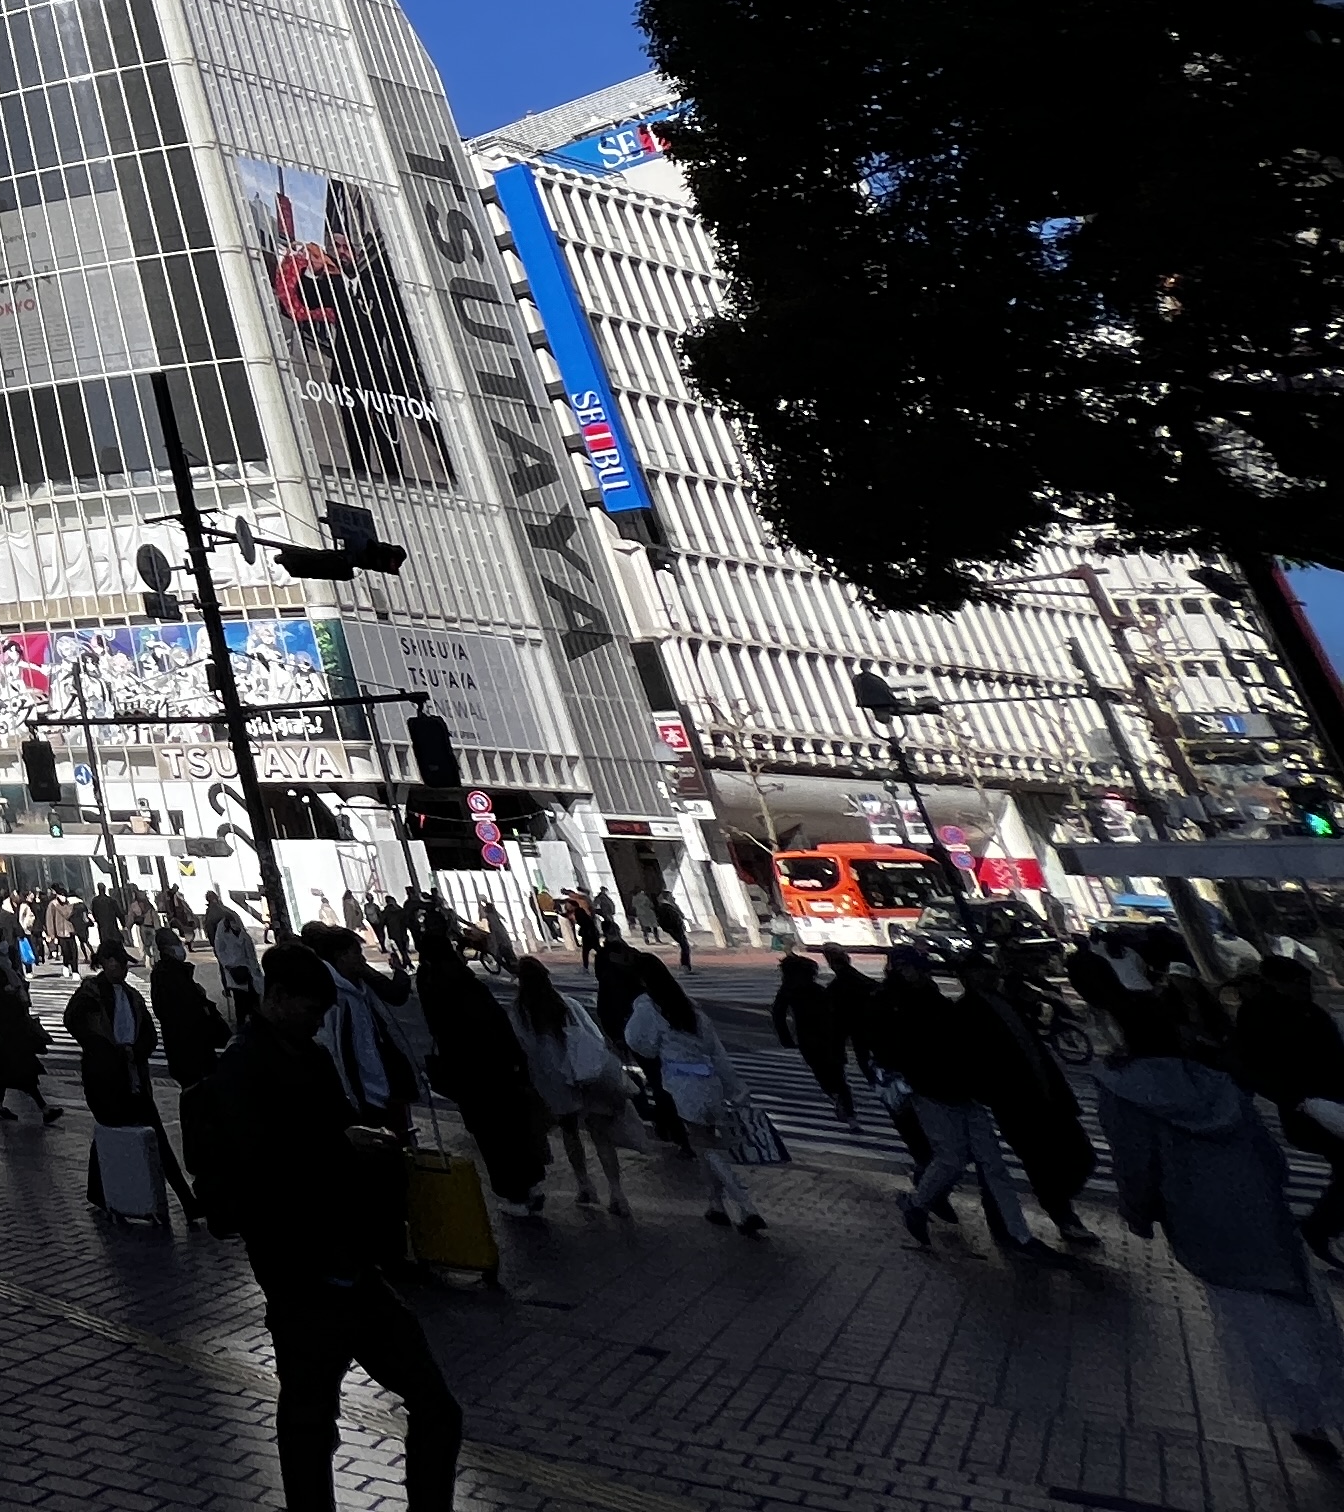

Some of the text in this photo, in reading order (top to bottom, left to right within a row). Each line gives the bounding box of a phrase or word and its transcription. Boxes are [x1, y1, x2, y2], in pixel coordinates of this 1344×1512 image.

[299, 380, 439, 423] LOUIS VUITTON
[405, 143, 614, 663] TSUTAYA
[571, 389, 630, 493] SEIBU
